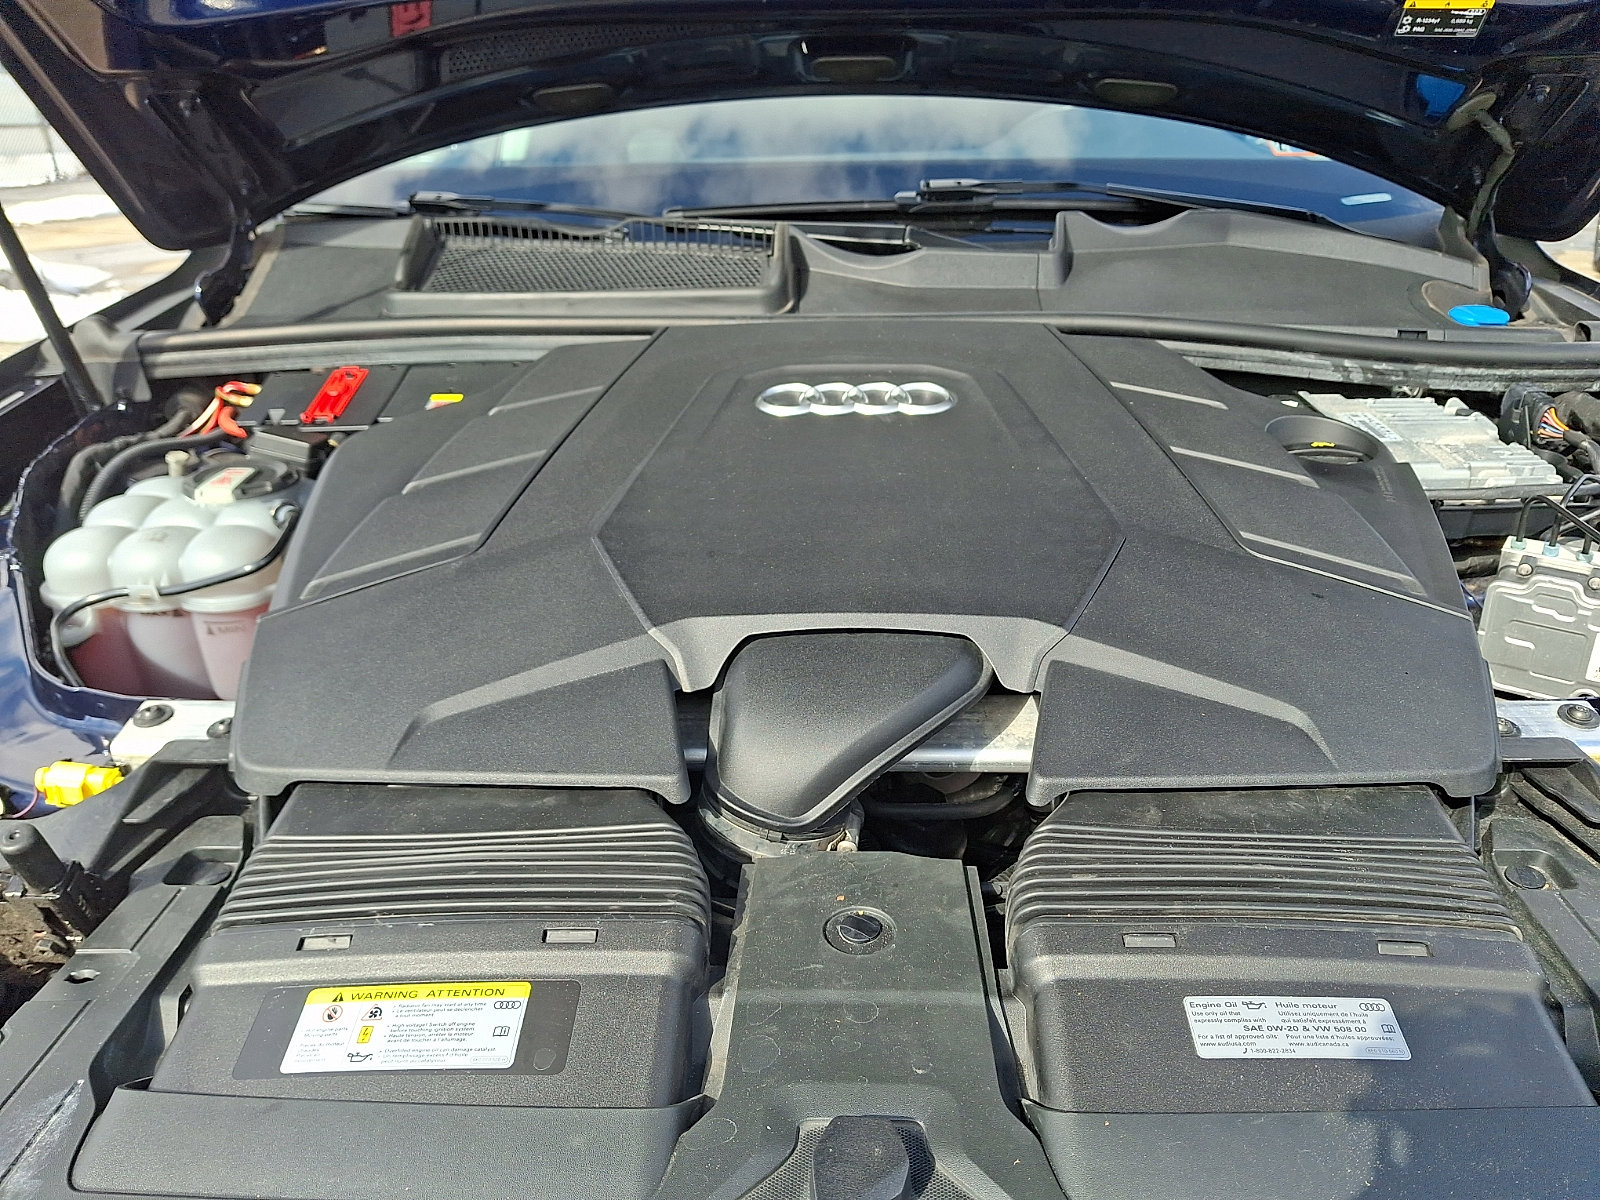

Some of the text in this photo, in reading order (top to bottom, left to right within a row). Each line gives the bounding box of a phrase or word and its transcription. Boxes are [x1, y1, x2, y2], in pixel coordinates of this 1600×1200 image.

[351, 988, 505, 1000] WARNING ATTENTION
[1189, 1001, 1222, 1010] Engine
[1275, 1001, 1300, 1009] Huile
[1302, 1010, 1340, 1018] uniquement
[1243, 1024, 1264, 1032] SAE
[1333, 1025, 1352, 1033] 508
